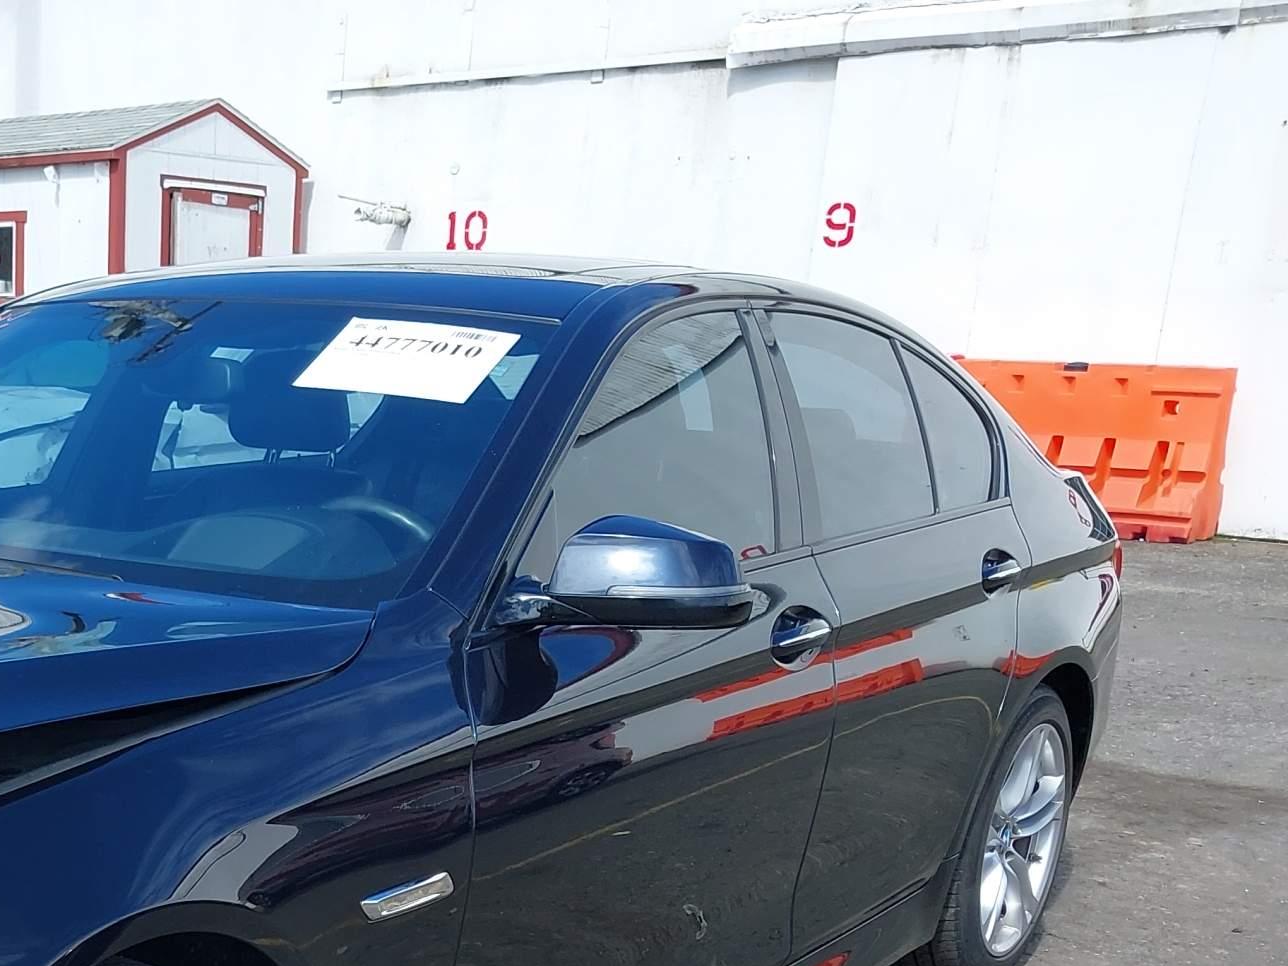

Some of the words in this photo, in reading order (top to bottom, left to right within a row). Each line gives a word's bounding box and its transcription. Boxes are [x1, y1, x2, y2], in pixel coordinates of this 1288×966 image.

[446, 210, 488, 251] 10
[823, 202, 856, 248] 9
[349, 335, 484, 359] 44777010
